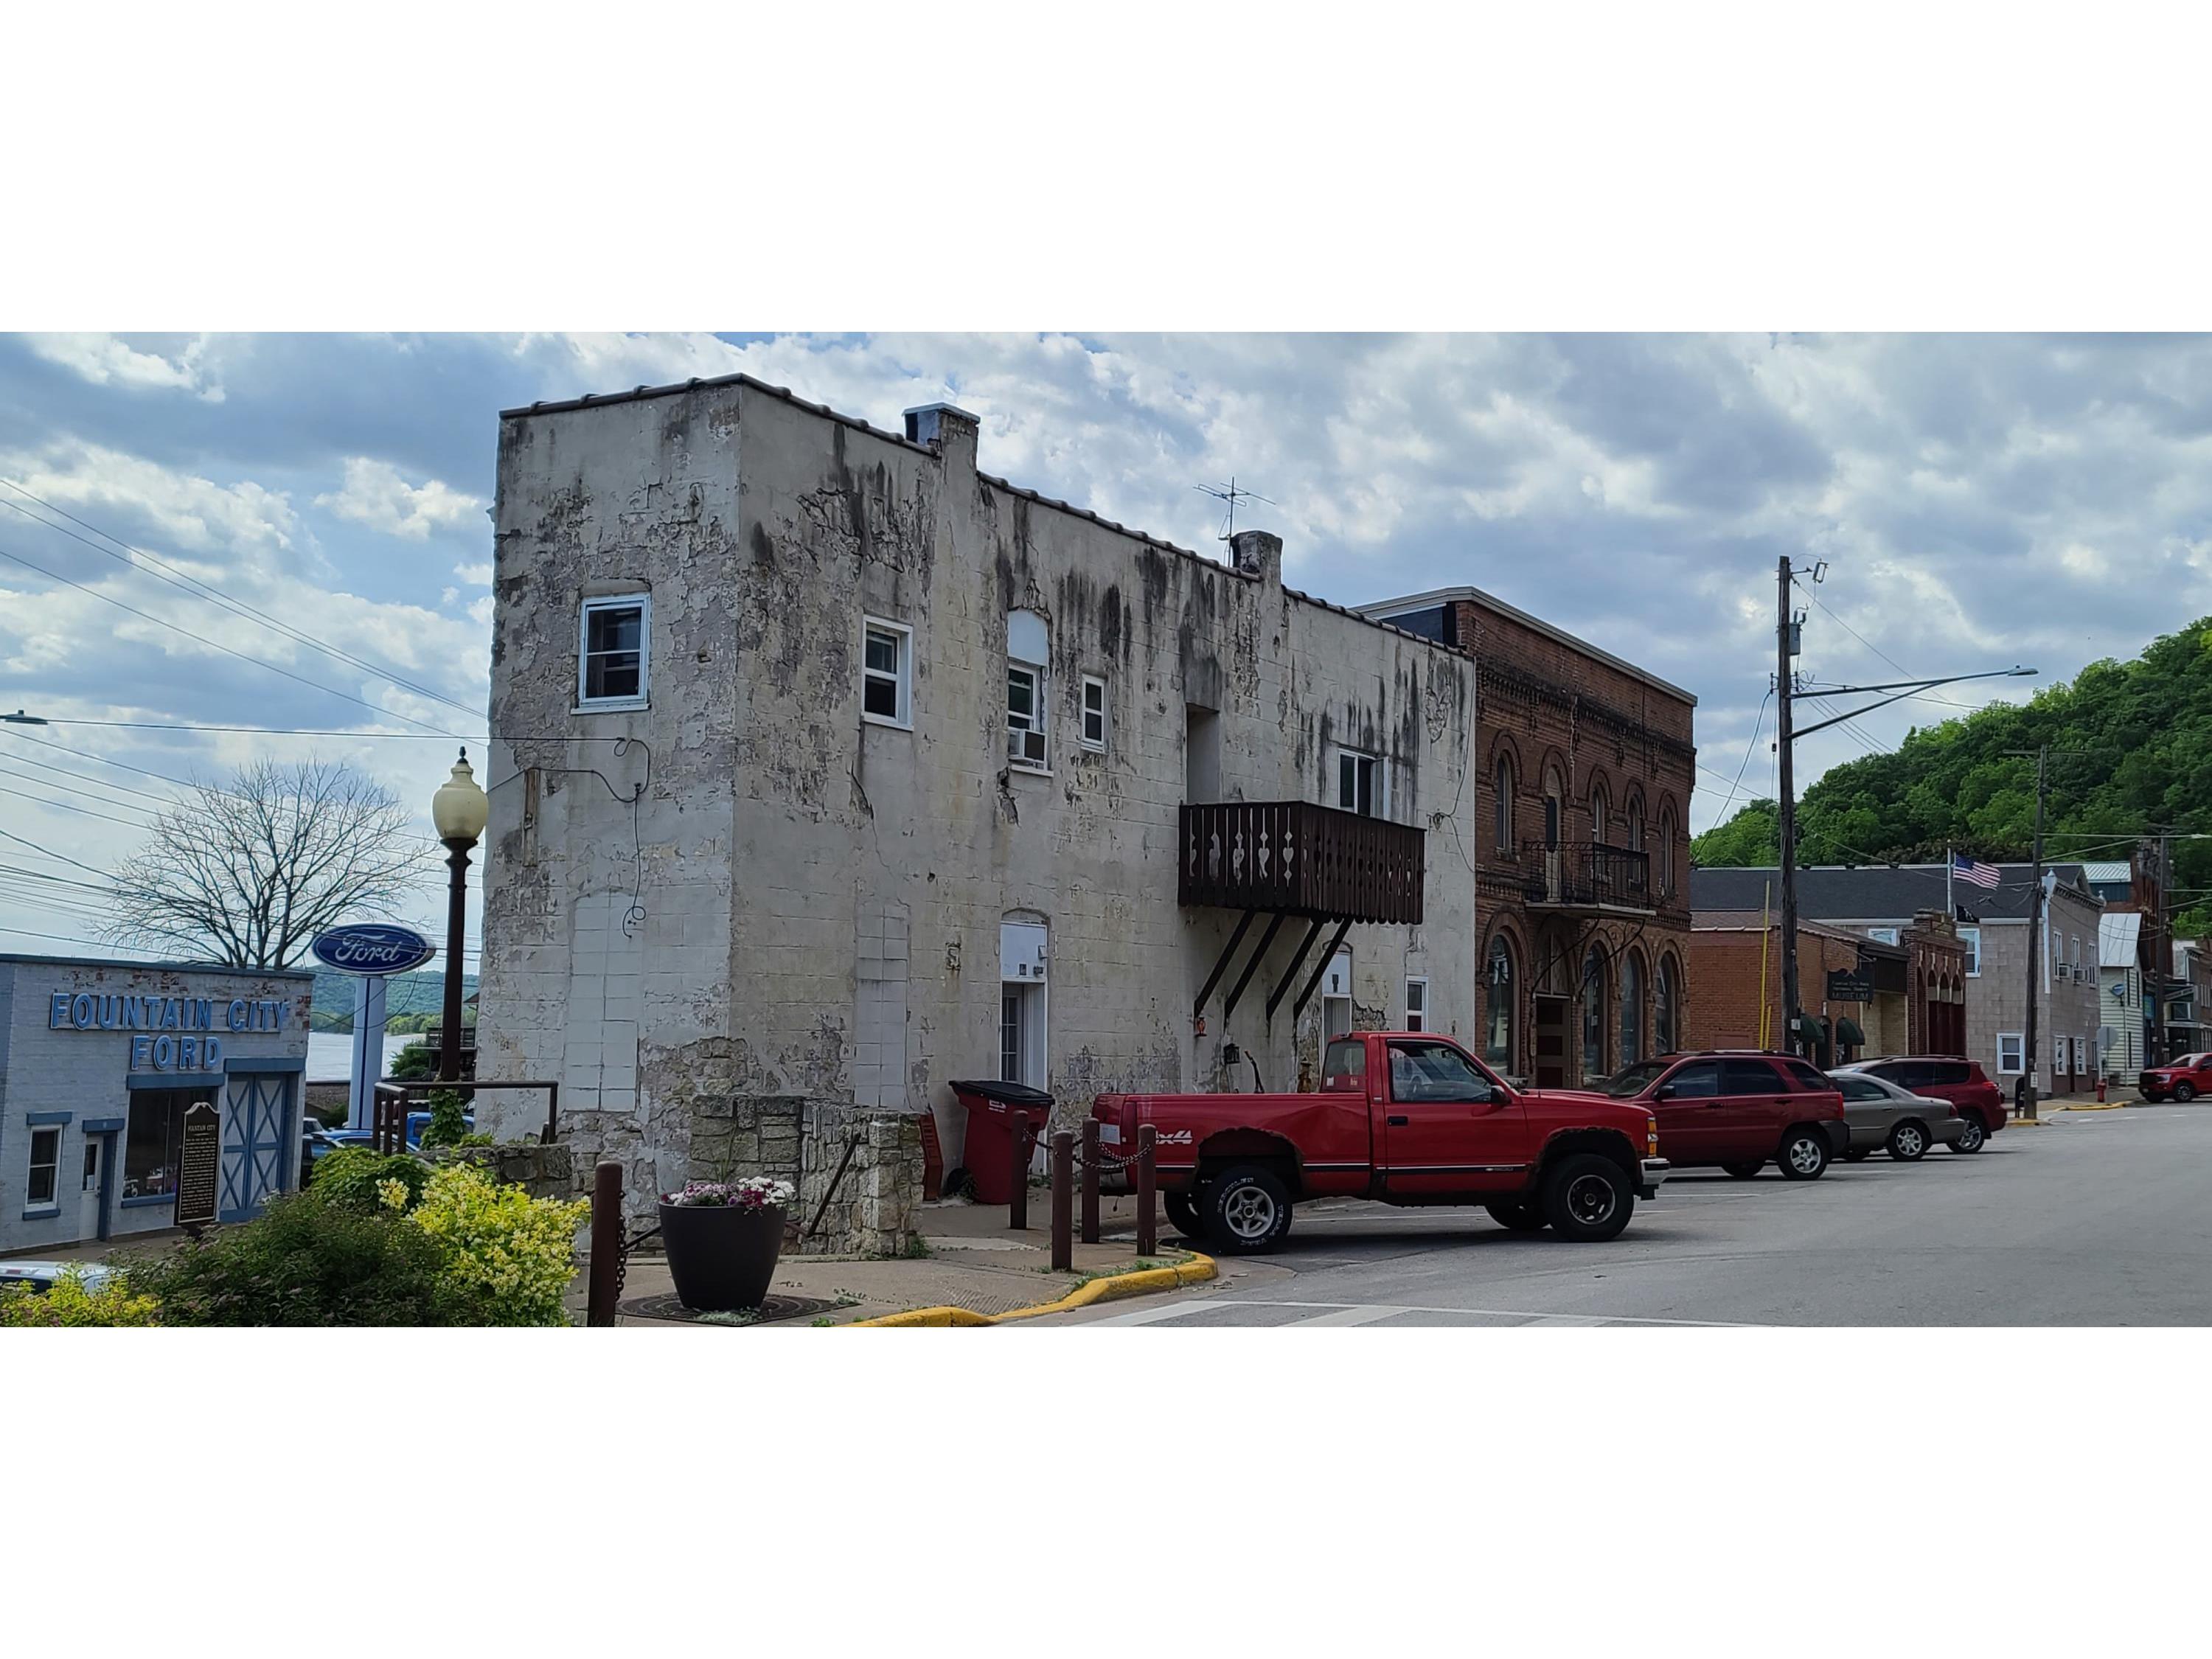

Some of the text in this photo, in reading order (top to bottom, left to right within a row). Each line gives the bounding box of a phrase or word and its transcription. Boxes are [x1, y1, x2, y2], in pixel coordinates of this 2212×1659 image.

[335, 932, 403, 961] Ford
[49, 992, 290, 1032] FOUNTAIN CITY
[131, 1034, 221, 1071] FORD
